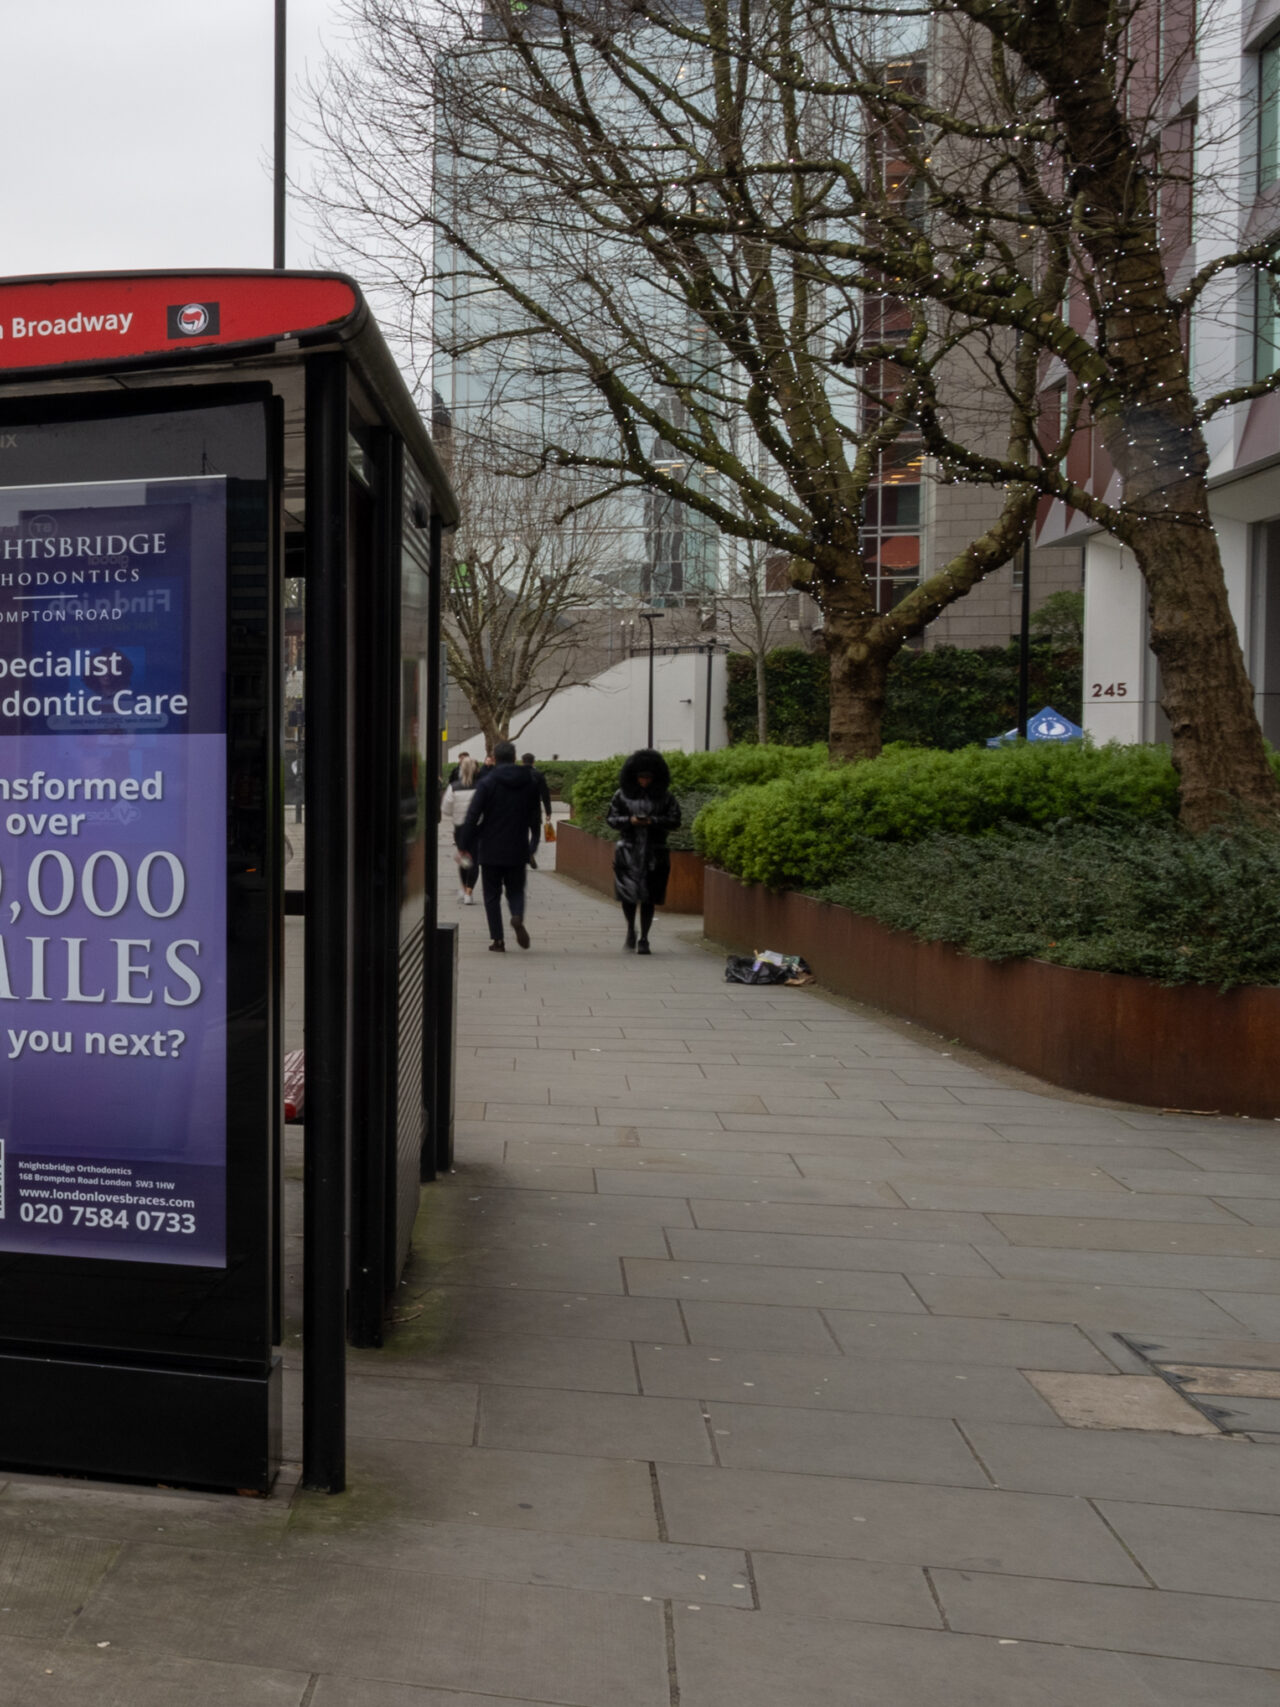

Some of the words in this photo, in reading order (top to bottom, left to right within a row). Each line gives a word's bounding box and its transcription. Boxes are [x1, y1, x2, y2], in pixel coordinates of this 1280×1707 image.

[11, 311, 134, 339] Broadway
[75, 608, 122, 621] ROAD
[1092, 683, 1127, 698] 245
[112, 689, 188, 717] Care
[6, 813, 85, 835] over
[8, 1029, 72, 1058] you
[85, 1029, 185, 1057] next?
[19, 1161, 75, 1173] Knightsbridge
[77, 1164, 132, 1175] Orthodontics
[34, 1174, 76, 1184] Brompton
[78, 1176, 99, 1185] Road
[100, 1178, 132, 1187] London
[135, 1180, 154, 1189] SW3
[156, 1181, 175, 1190] 1HW
[19, 1188, 195, 1208] www.londonlovesbraces.com
[20, 1203, 63, 1224] 020
[70, 1206, 129, 1229] 7584
[136, 1211, 196, 1233] 0733
